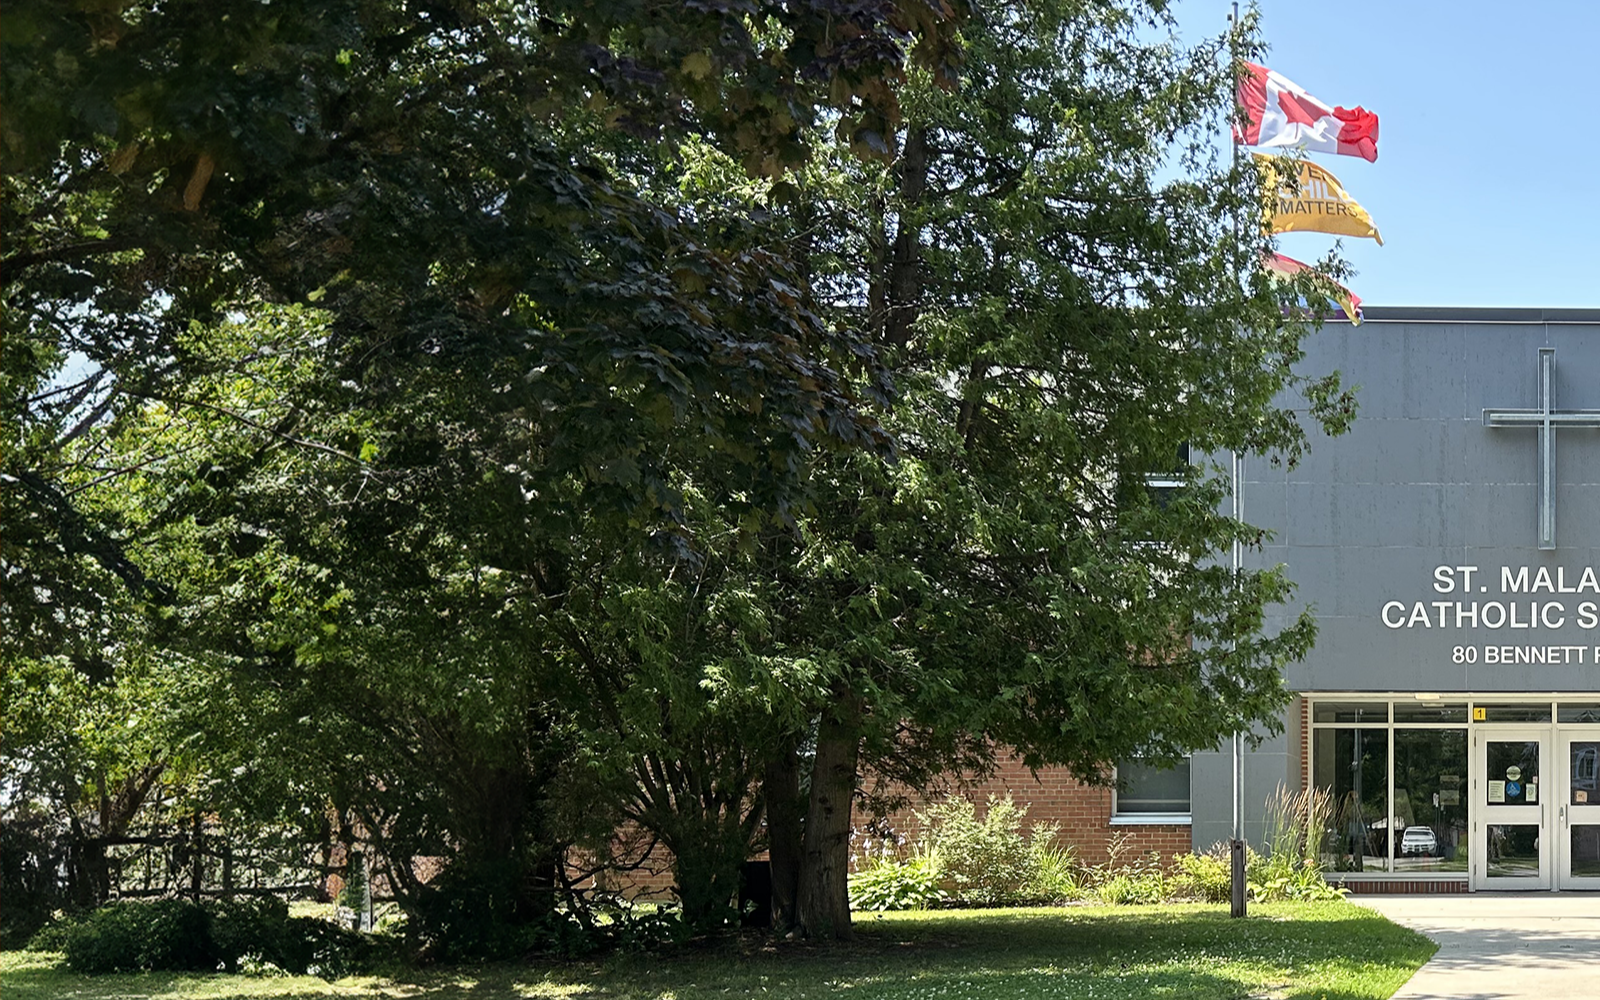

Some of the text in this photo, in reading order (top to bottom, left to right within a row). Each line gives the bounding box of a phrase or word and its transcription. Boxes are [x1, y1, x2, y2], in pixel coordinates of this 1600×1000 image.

[1280, 200, 1358, 217] MATTERS
[1433, 565, 1487, 594] ST.
[1381, 600, 1565, 629] CATHOLIC
[1452, 645, 1477, 664] 80
[1484, 645, 1588, 664] BENNETT
